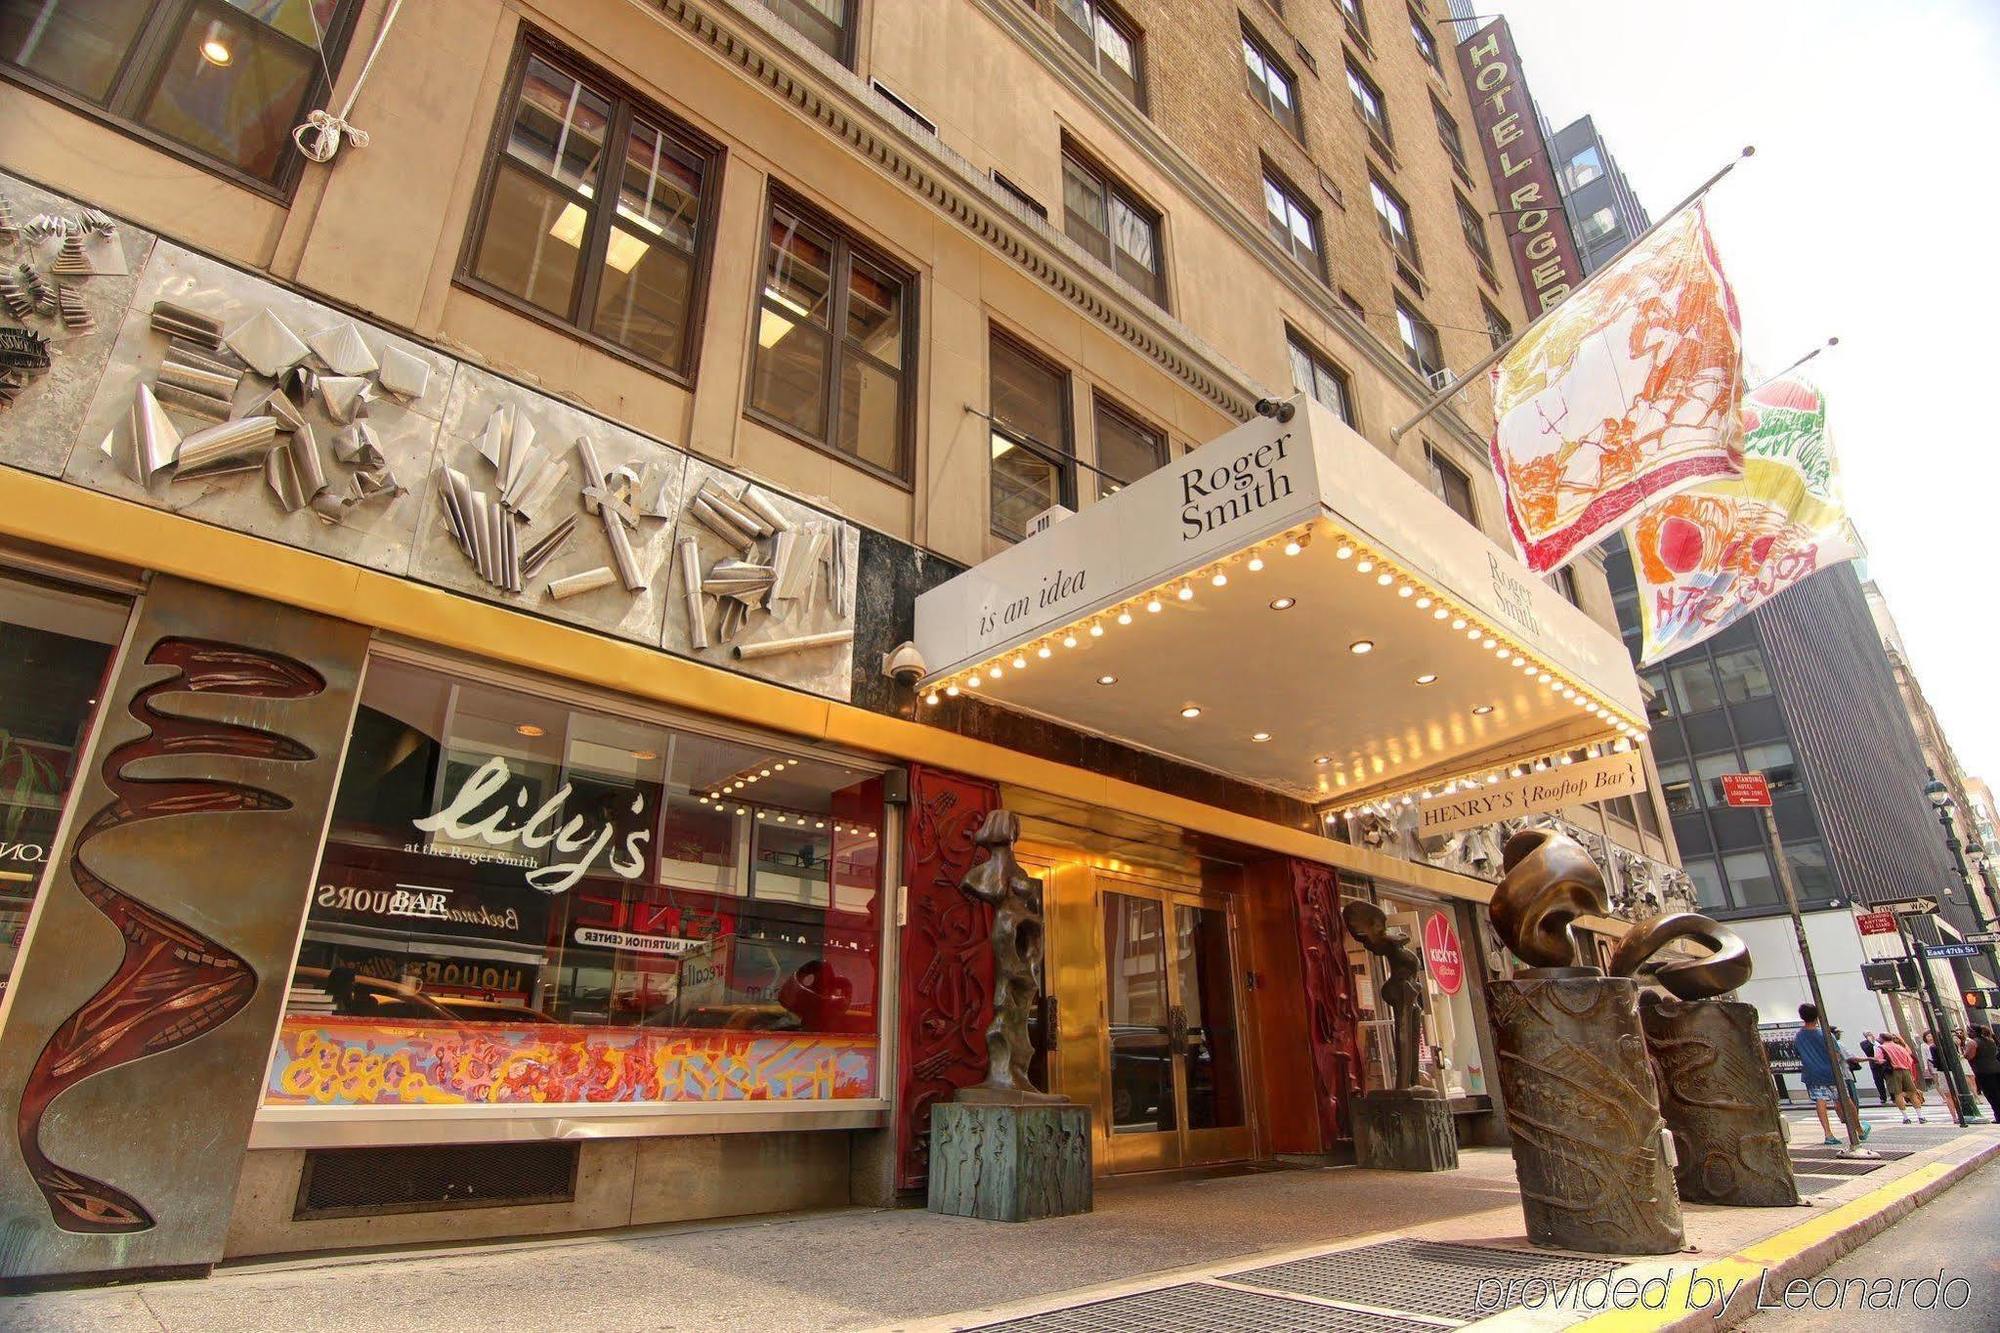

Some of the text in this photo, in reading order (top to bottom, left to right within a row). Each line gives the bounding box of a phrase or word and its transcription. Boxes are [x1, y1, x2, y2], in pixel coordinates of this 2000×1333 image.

[1469, 33, 1533, 178] HOTEL
[1179, 432, 1292, 507] Roger
[1182, 467, 1293, 542] Smith
[979, 568, 1087, 636] is an idea
[1486, 551, 1532, 606] Roger
[1493, 582, 1540, 637] Smith
[1424, 791, 1514, 826] HENRY'S
[404, 842, 539, 870] at the Roger Smith
[394, 889, 448, 913] BAR
[1879, 901, 1931, 912] ONE WAY
[1926, 948, 1944, 956] East
[1945, 947, 1964, 955] 47th
